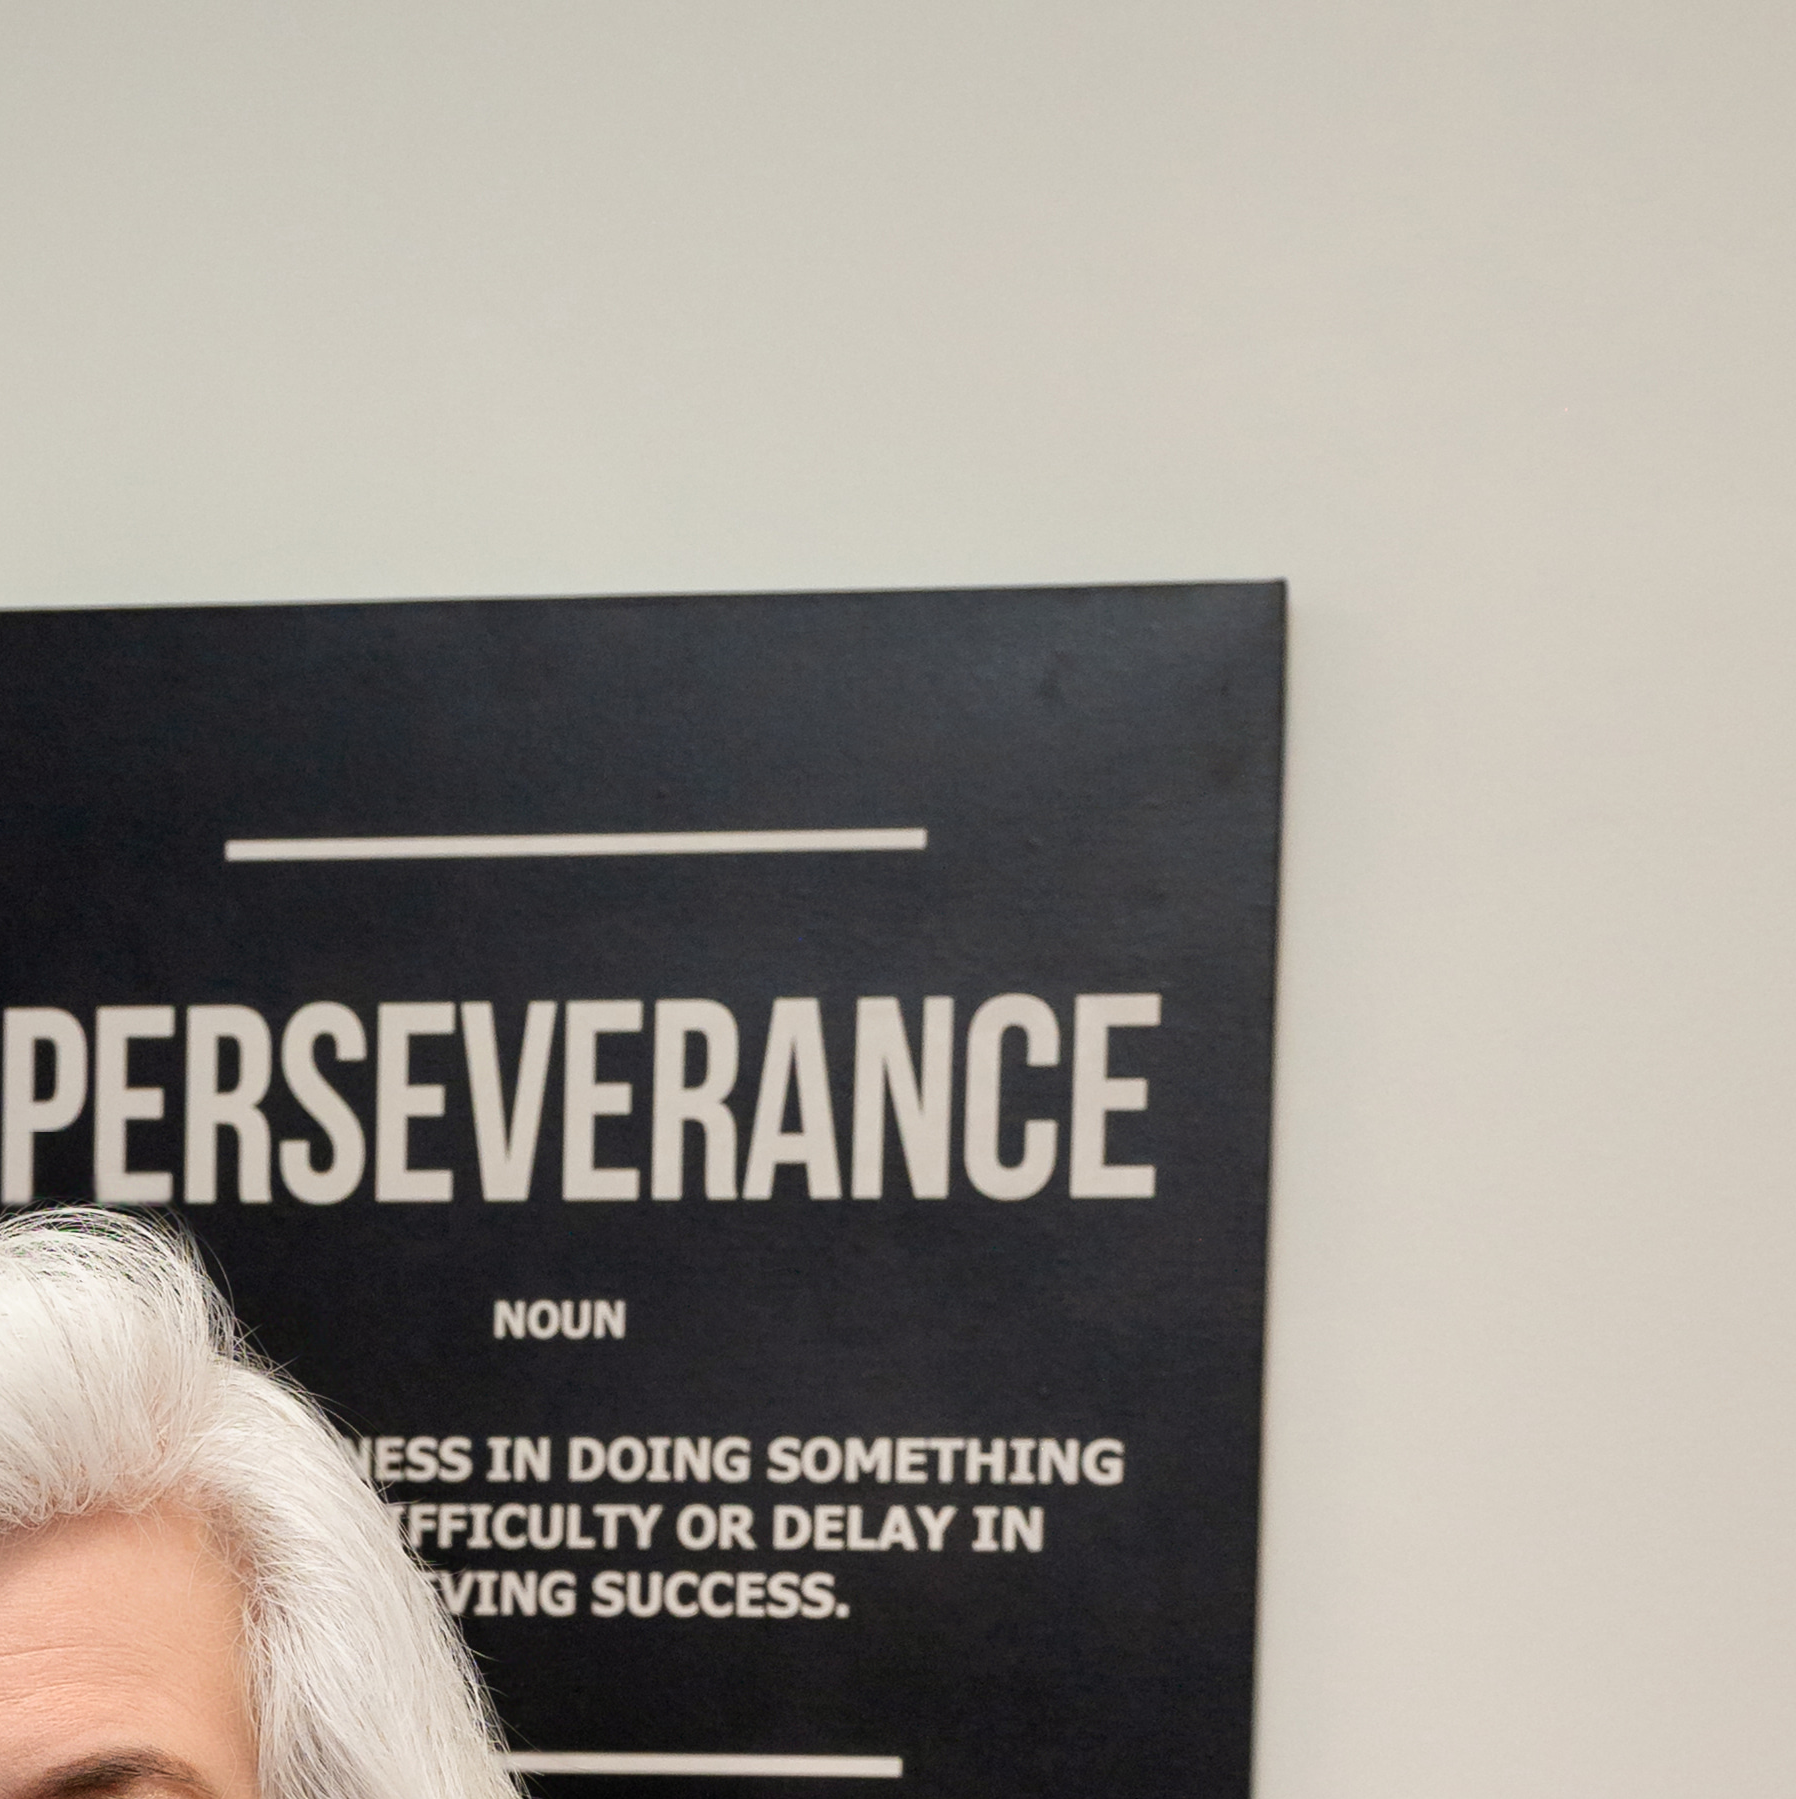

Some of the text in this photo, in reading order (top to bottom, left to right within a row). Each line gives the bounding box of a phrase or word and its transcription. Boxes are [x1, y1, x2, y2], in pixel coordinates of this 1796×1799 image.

[0, 991, 1164, 1206] PERSEVERANCE
[492, 1298, 628, 1341] NOUN
[485, 1435, 552, 1483] IN
[566, 1434, 753, 1485] DOING
[765, 1434, 1126, 1487] SOMETHING
[675, 1502, 758, 1552] OR
[771, 1503, 960, 1553] DELAY
[970, 1504, 1046, 1554] IN
[590, 1570, 851, 1620] SUCCESS.
